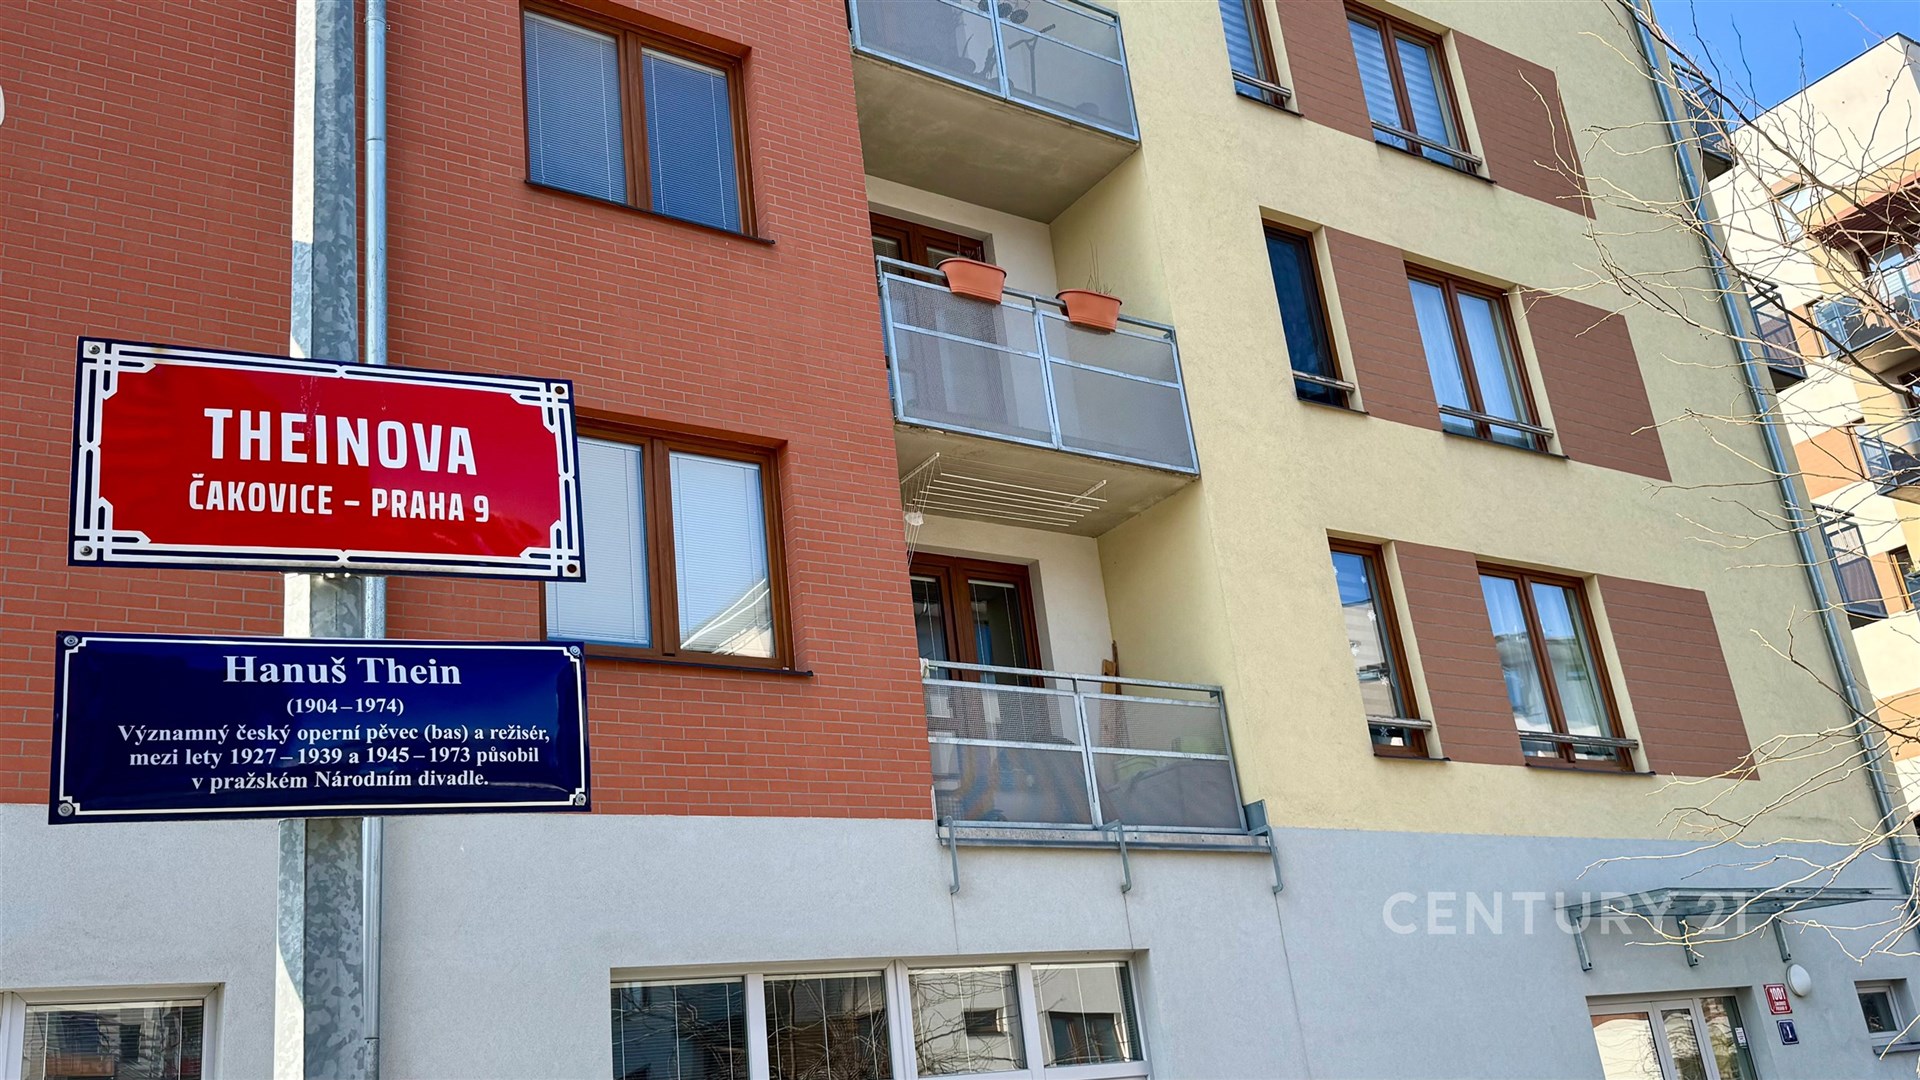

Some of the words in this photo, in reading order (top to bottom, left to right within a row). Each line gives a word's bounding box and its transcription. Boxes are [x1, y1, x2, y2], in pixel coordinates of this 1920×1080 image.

[203, 407, 477, 476] THEINOVA
[189, 473, 333, 515] ČAKOVICE
[371, 487, 465, 522] PRAHA
[473, 495, 490, 523] 9
[223, 655, 347, 684] Hanuš
[356, 657, 462, 685] Thein
[117, 724, 230, 746] Významný
[236, 724, 291, 745] český
[297, 724, 361, 745] operní
[366, 723, 419, 744] pěvec
[423, 724, 469, 744] (bas)
[474, 728, 485, 740] a
[489, 724, 550, 744] režisér,
[129, 748, 178, 766] mezi
[185, 748, 223, 769] lety
[348, 752, 360, 764] a
[476, 745, 539, 767] působil
[191, 777, 204, 790] v
[209, 771, 308, 794] pražském
[314, 769, 412, 788] Národním
[417, 769, 489, 786] divadle.
[1769, 987, 1786, 1000] 1001
[1786, 1024, 1793, 1039] 1
